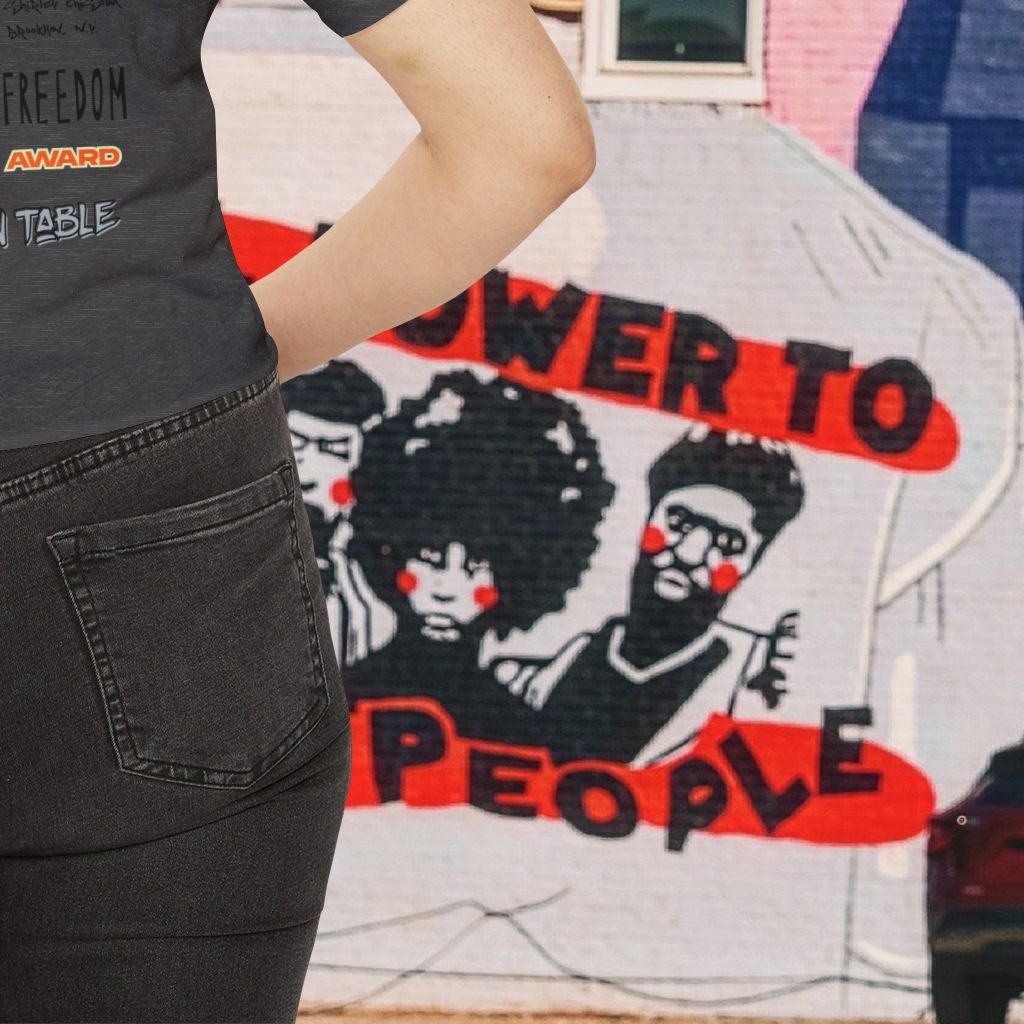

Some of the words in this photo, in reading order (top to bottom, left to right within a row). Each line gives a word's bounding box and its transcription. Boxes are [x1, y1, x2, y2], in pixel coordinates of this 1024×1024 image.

[2, 66, 128, 125] FREEDOM
[4, 145, 123, 172] AWARD
[15, 200, 122, 247] TABLE
[784, 338, 934, 455] TO
[370, 705, 883, 853] PEOPLE
